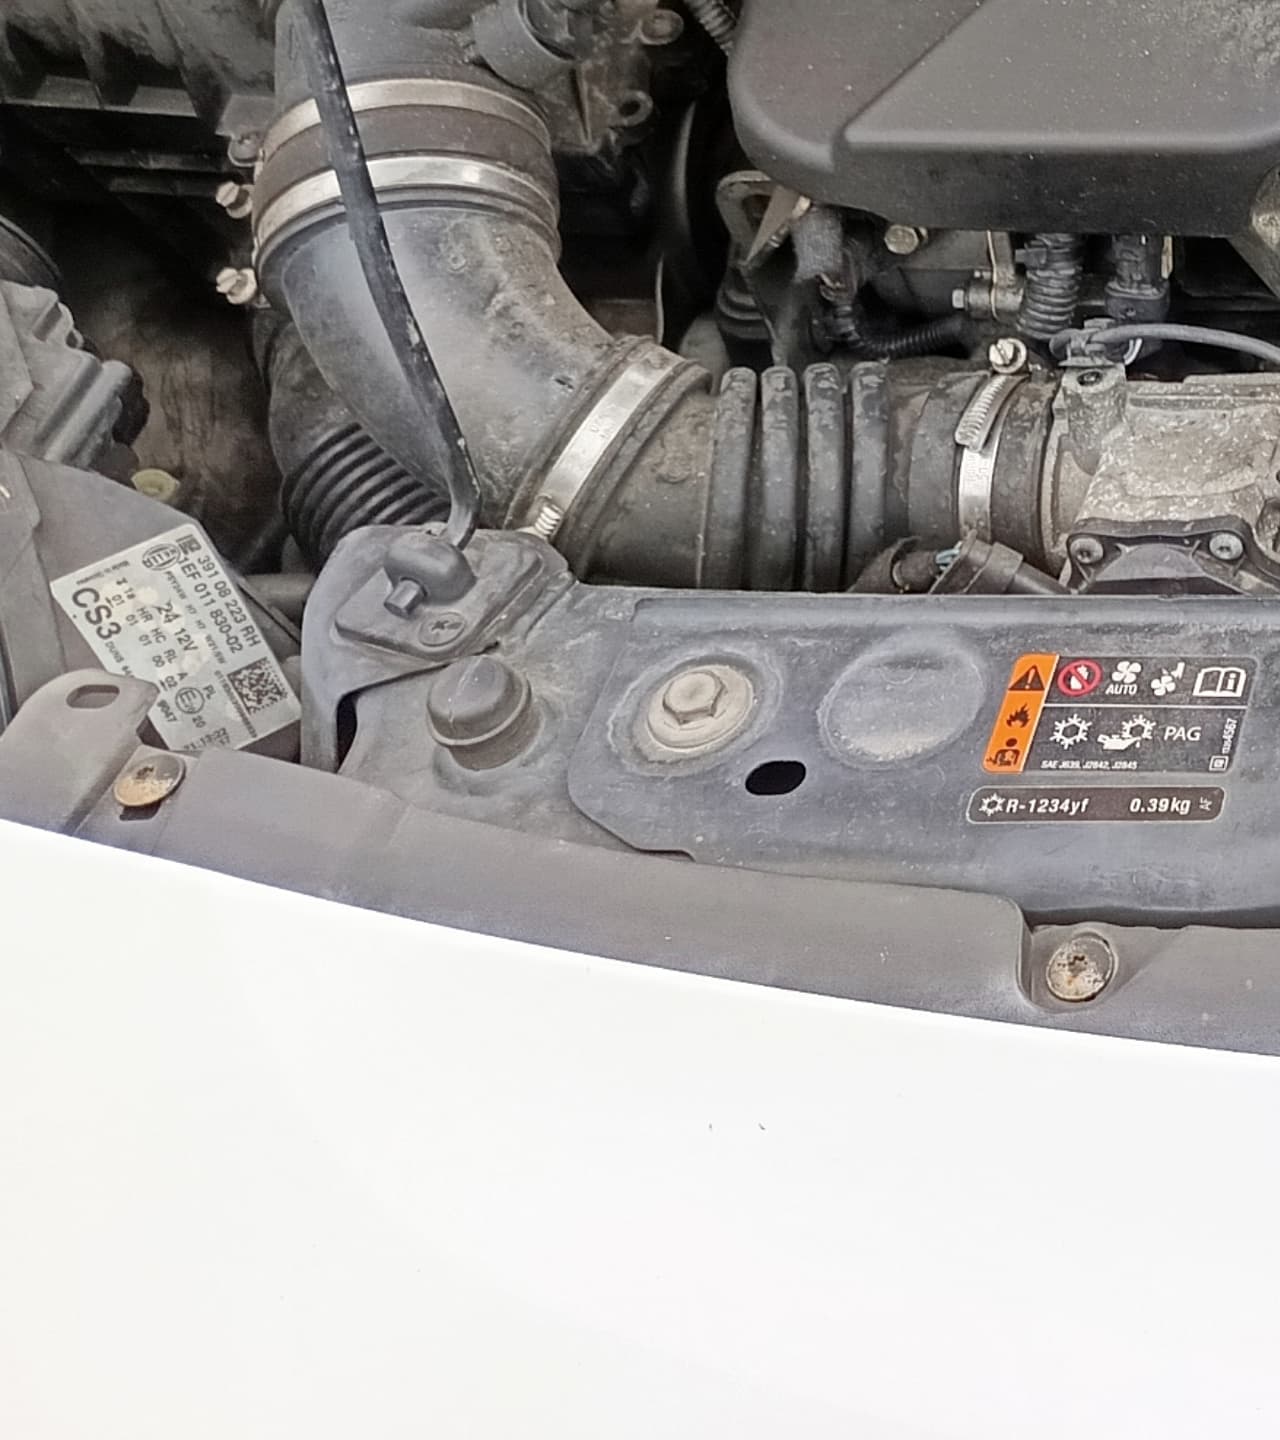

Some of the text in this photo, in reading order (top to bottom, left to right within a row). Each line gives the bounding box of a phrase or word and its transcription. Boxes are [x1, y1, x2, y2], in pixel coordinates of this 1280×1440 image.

[176, 557, 202, 580] 1EF
[194, 583, 216, 606] 011
[210, 609, 243, 654] 830-02
[198, 556, 261, 647] 391 08 223 RH
[72, 588, 122, 640] CS3
[175, 628, 198, 651] 12V
[1106, 684, 1137, 695] AUTO
[1164, 726, 1201, 741] PAG
[1041, 760, 1057, 769] SAE
[1007, 798, 1089, 815] R-1234yf
